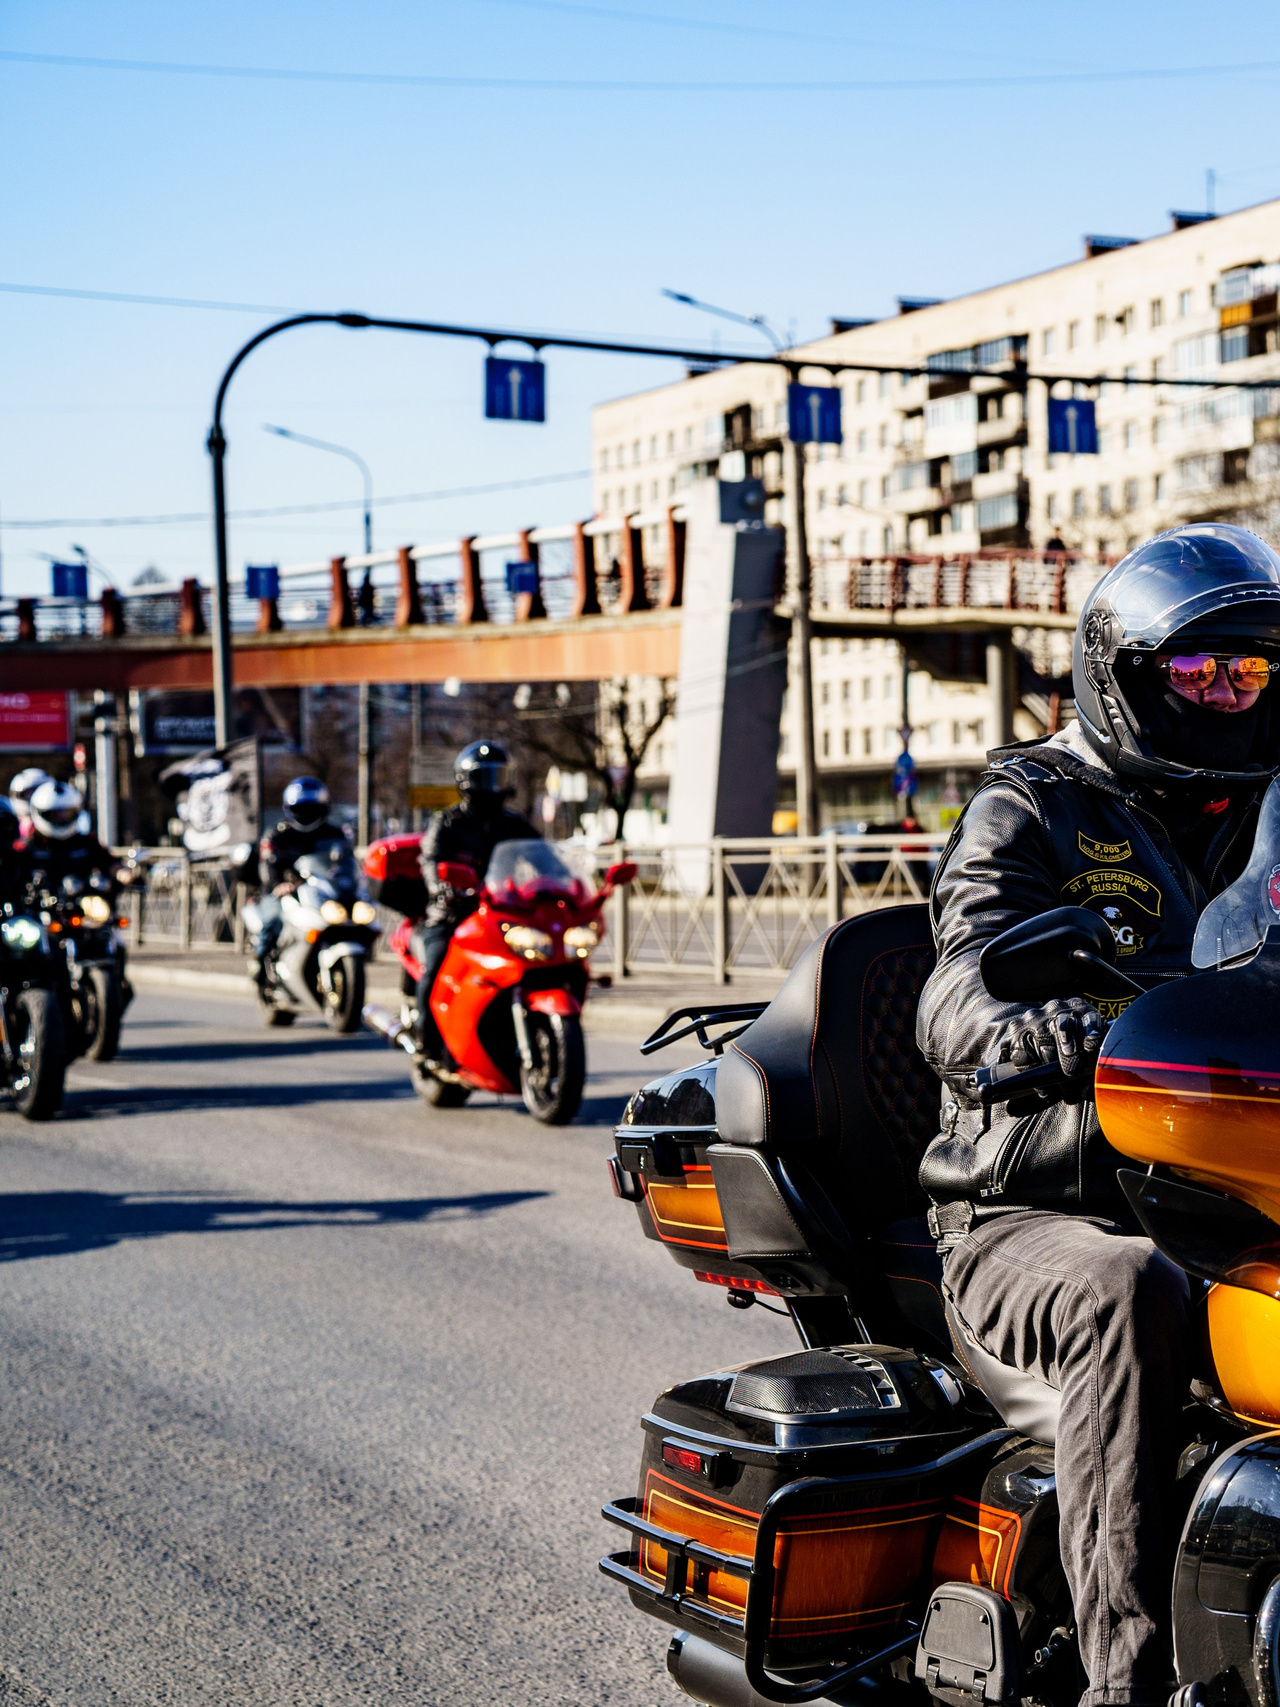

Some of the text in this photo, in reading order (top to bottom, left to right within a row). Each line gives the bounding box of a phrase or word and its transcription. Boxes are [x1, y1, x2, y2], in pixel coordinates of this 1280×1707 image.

[1094, 843, 1120, 854] 9,000
[1069, 872, 1149, 892] ST. PETERSBURG
[1091, 882, 1127, 893] RUSSIA
